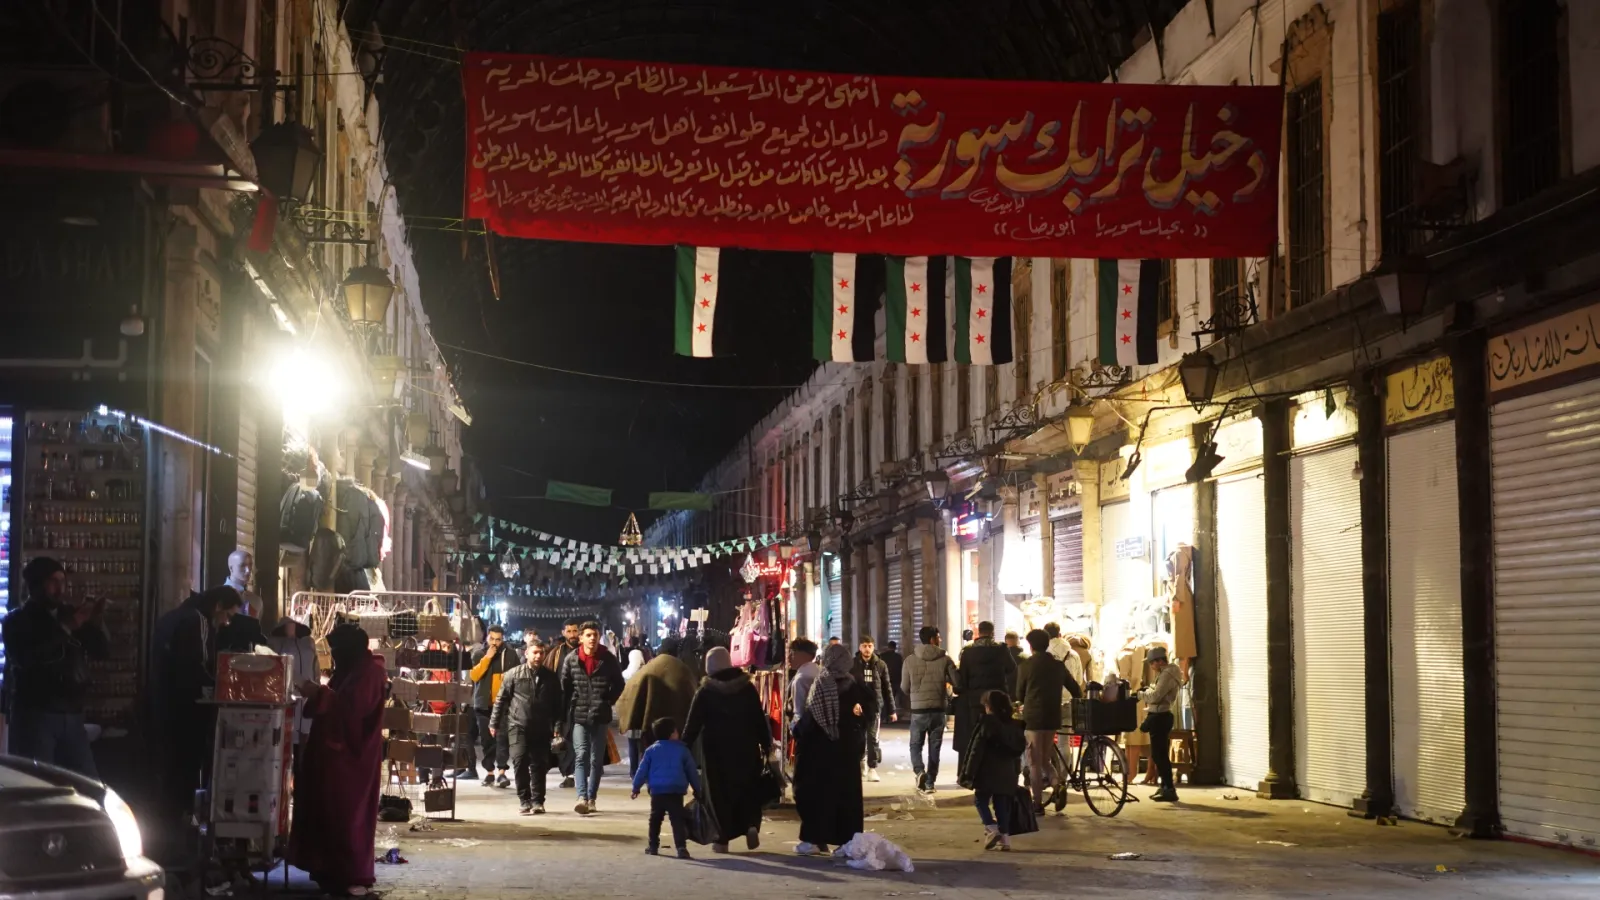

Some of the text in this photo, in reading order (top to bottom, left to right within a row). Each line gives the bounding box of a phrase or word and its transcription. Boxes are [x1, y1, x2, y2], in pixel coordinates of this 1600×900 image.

[481, 58, 547, 91] الحرية
[548, 60, 615, 90] وحلت
[614, 65, 688, 100] والظلم
[784, 75, 826, 106] زمن
[825, 75, 880, 109] انتهى
[474, 94, 536, 135] سوريا
[535, 104, 595, 136] عاشت
[592, 107, 654, 144] سوريا
[651, 106, 696, 145] أهل
[694, 110, 766, 148] طوائف
[762, 114, 810, 155] لجميع
[472, 137, 531, 173] والوطن
[528, 144, 578, 178] للوطن
[600, 149, 663, 183] الطائفية
[662, 149, 703, 184] تعرف
[891, 89, 1268, 216] دخيل ترابك سورية
[699, 156, 720, 183] لا
[720, 151, 752, 188] قبل
[749, 160, 775, 187] من
[776, 153, 816, 185] كانت
[826, 157, 865, 193] الحرية
[855, 165, 888, 190] بعد
[640, 189, 674, 217] الدول
[671, 187, 692, 216] كل
[685, 194, 704, 217] من
[703, 193, 753, 222] ونطلب
[789, 196, 831, 224] خاص
[825, 200, 865, 230] وليس
[896, 203, 914, 226] لنا
[866, 204, 896, 233] عام
[1095, 213, 1142, 237] سوريا
